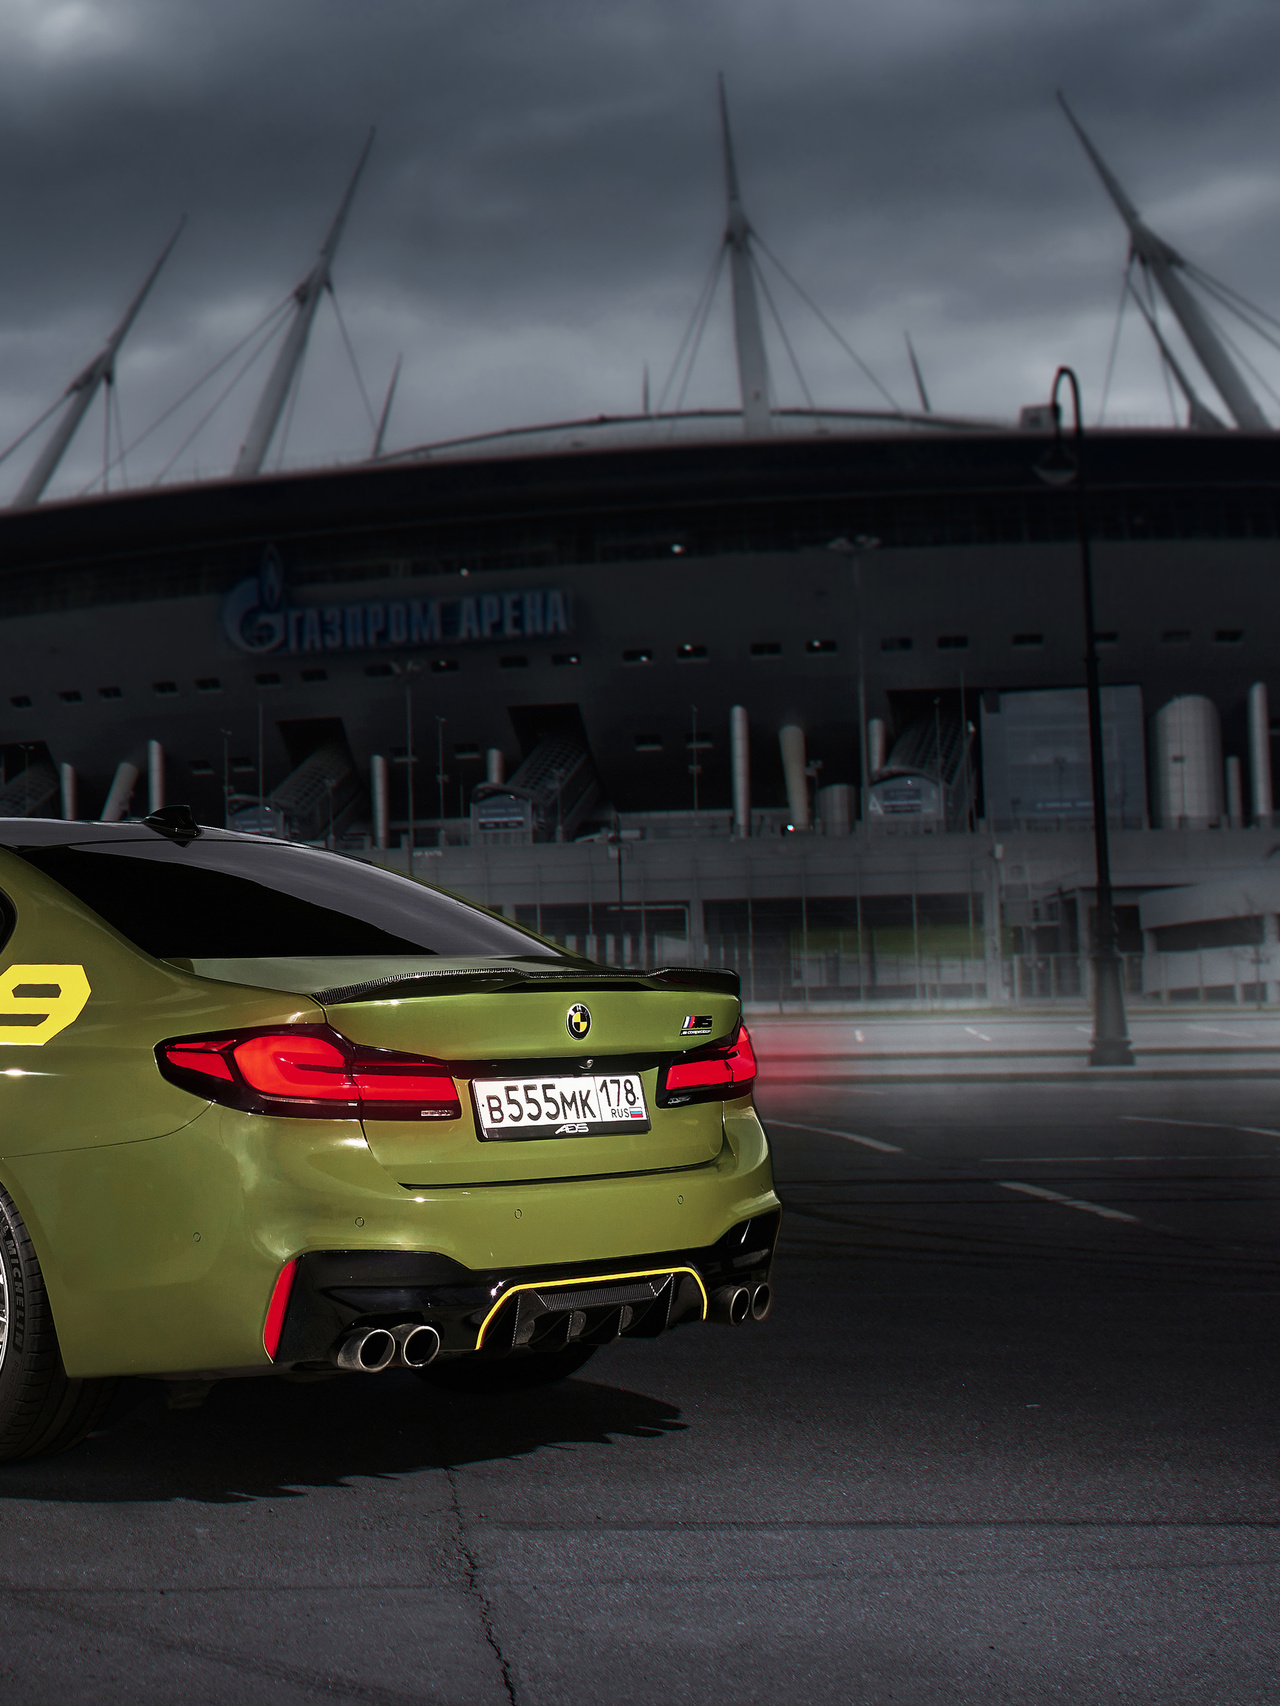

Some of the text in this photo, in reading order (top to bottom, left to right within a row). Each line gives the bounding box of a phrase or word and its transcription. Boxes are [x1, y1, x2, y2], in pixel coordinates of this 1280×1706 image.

[288, 589, 570, 651] ГАЗПРОМ АРЕНА
[599, 1079, 636, 1107] 178
[611, 1107, 630, 1118] RUS
[6, 1239, 25, 1349] MICHELIN
